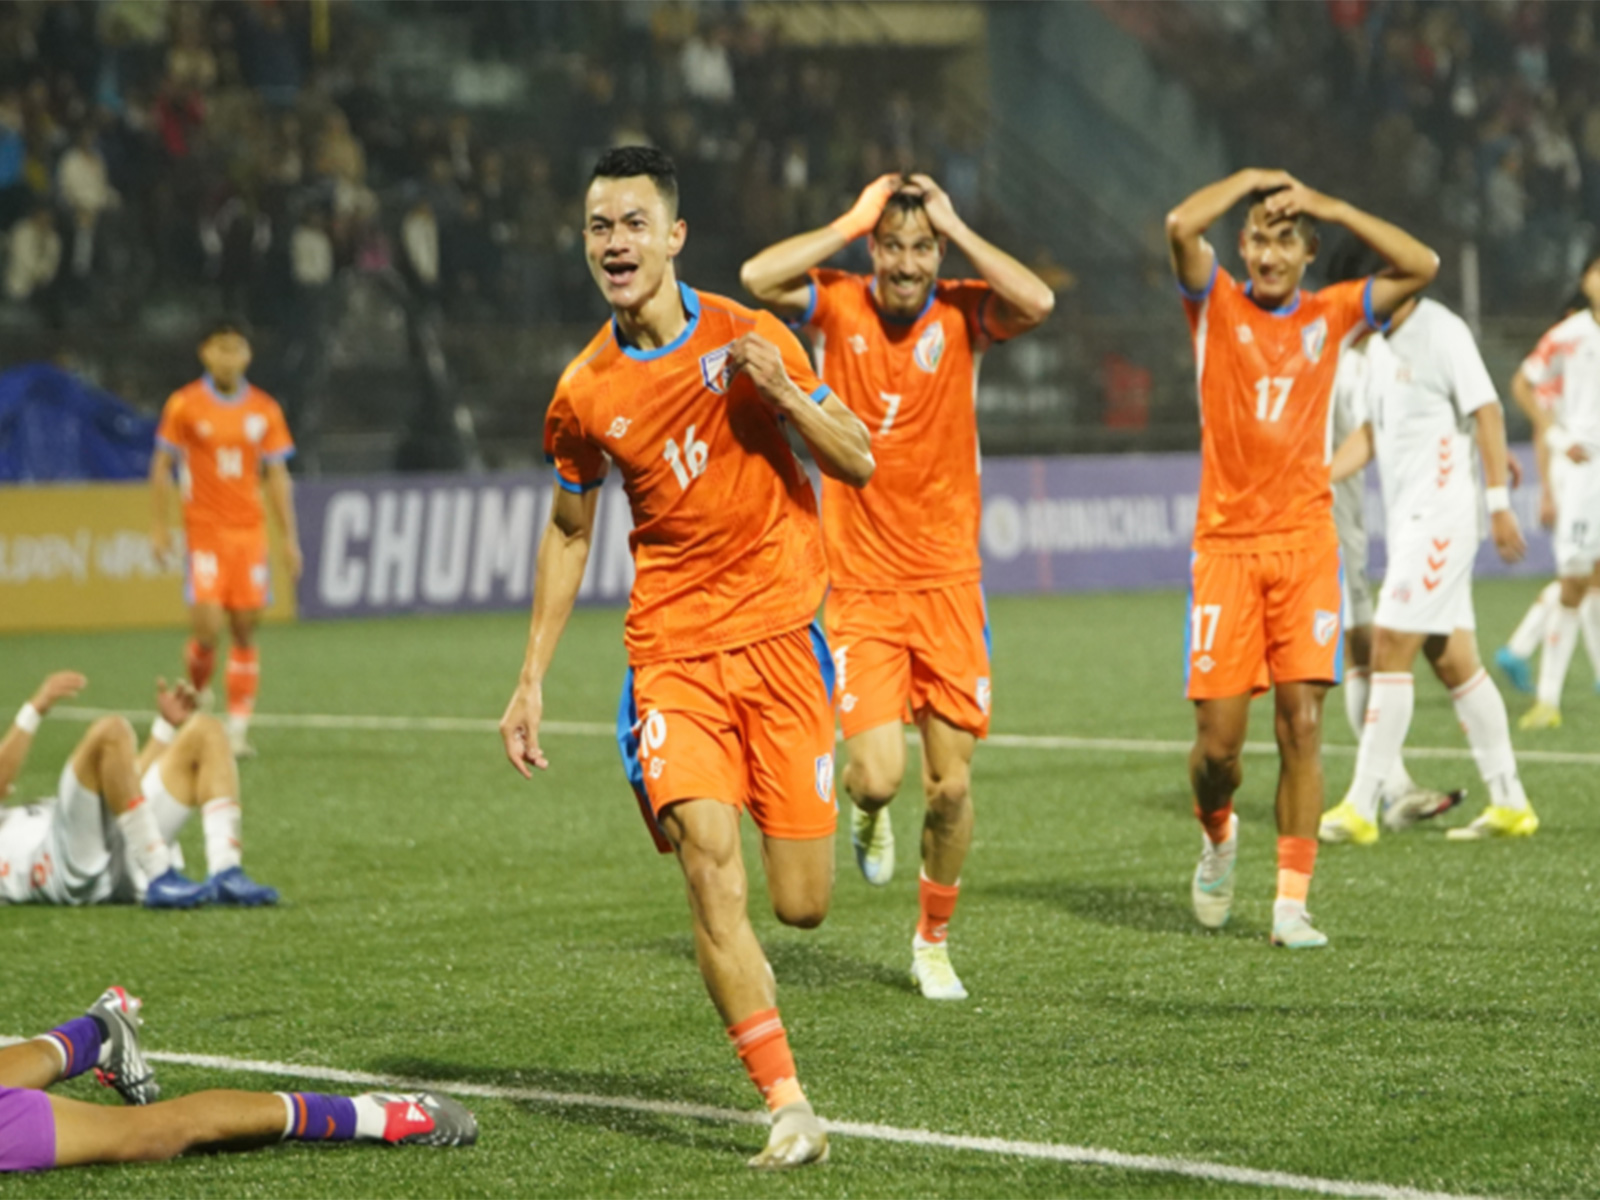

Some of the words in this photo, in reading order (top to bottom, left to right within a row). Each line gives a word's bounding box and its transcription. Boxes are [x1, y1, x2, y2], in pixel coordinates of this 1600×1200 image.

[880, 390, 902, 434] 7
[1255, 375, 1294, 421] 17
[663, 423, 708, 491] 16
[1192, 604, 1222, 651] 17
